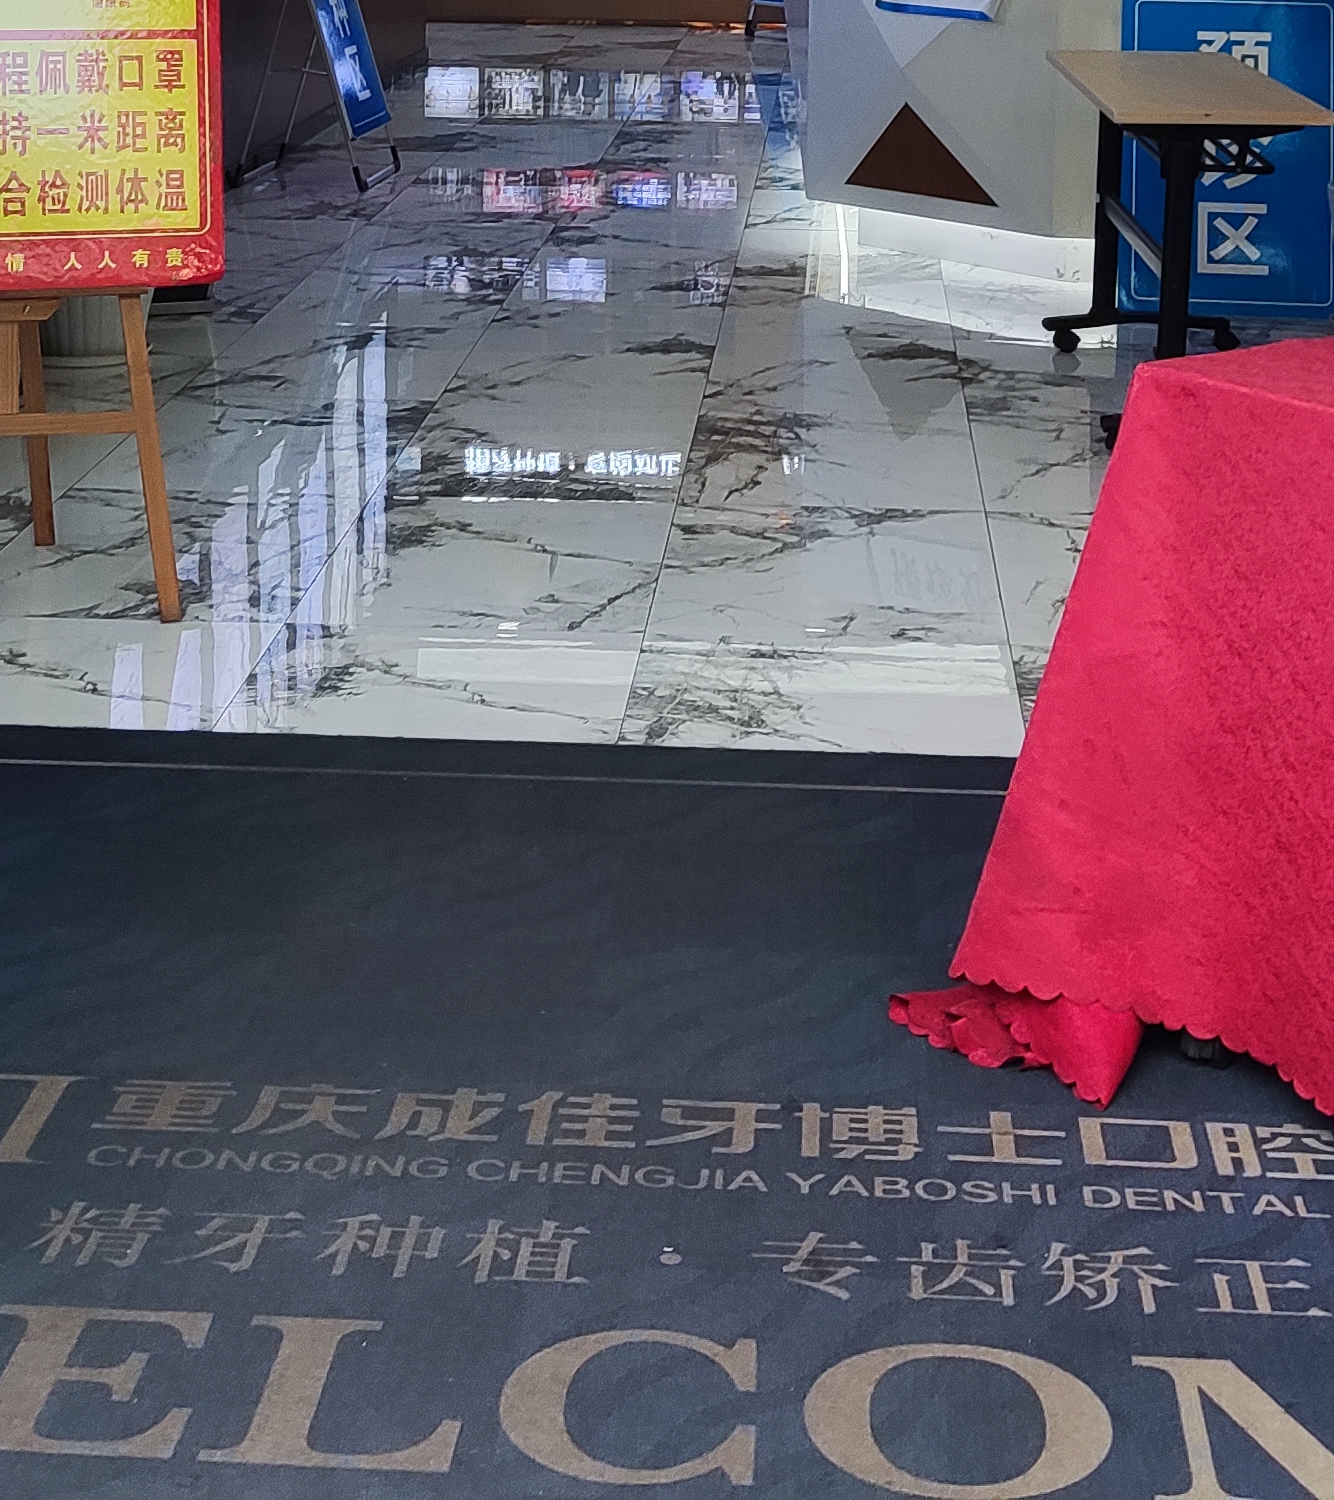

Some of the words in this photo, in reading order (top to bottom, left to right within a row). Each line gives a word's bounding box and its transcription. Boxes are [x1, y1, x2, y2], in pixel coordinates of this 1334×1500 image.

[86, 1143, 448, 1183] CHONGQING
[466, 1157, 767, 1195] CHENGJIA
[784, 1172, 1058, 1208] YABOSHI
[1083, 1185, 1331, 1221] DENTAL
